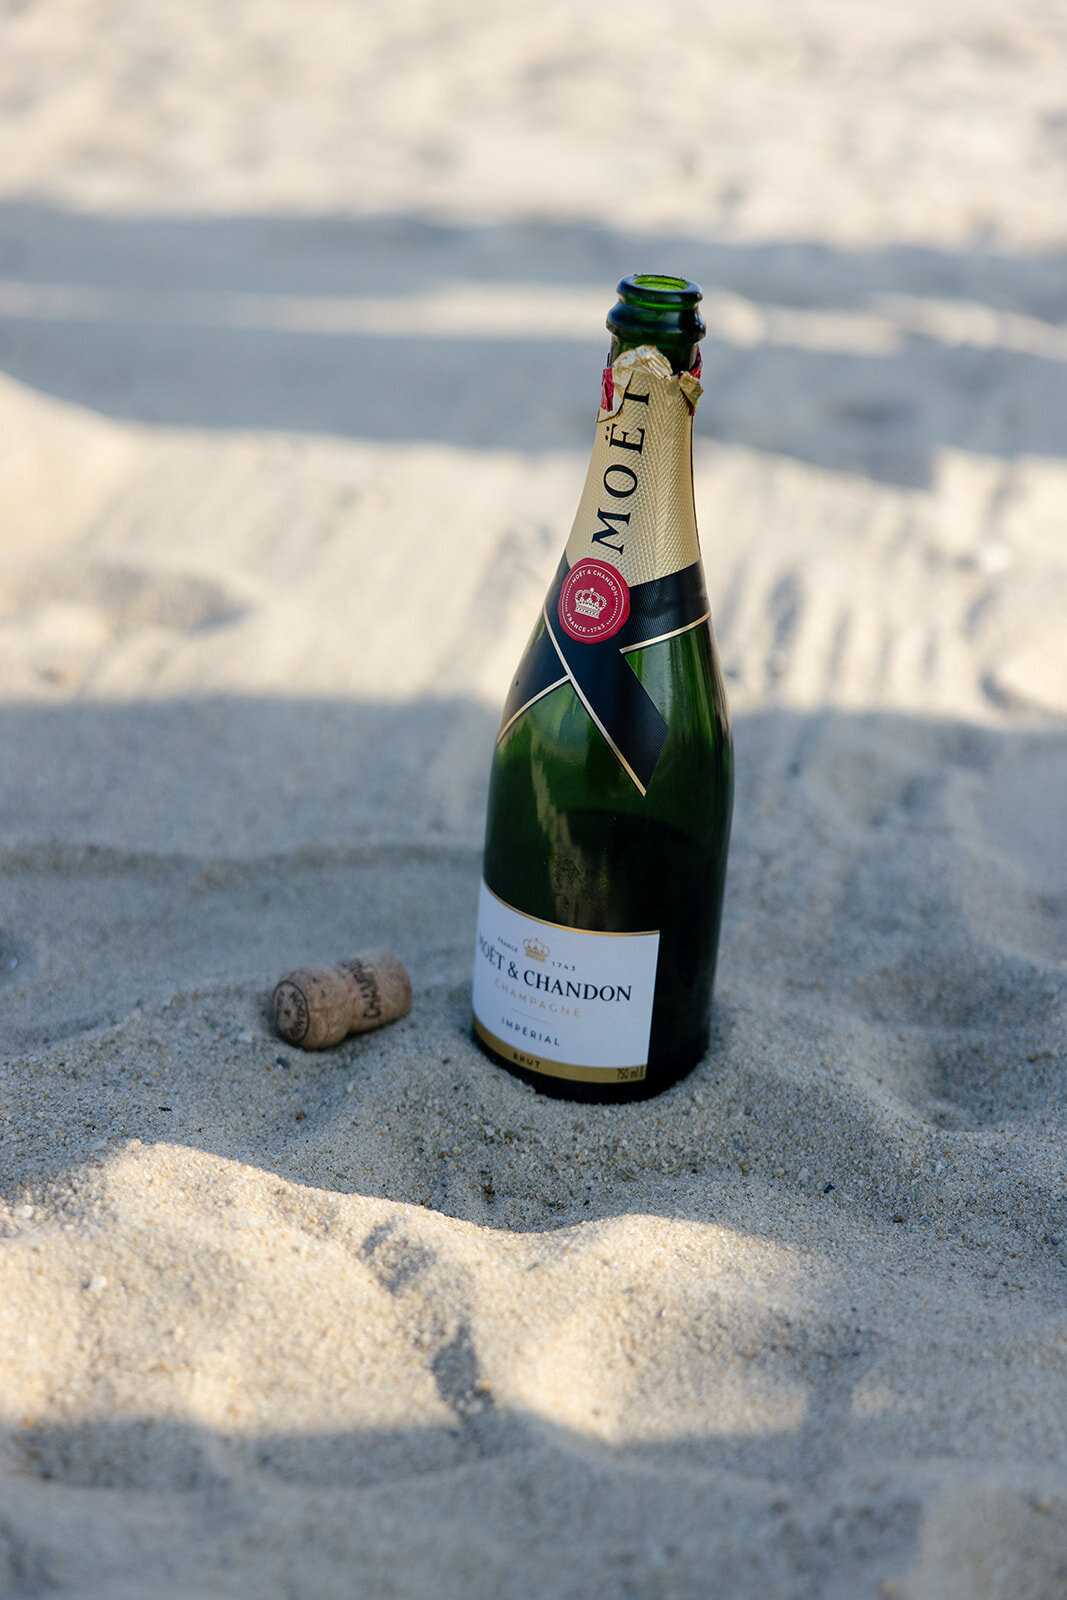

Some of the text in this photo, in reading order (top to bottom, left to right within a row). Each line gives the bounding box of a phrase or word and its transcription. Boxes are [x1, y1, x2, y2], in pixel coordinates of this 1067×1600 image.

[593, 570, 618, 596] CHANDON
[566, 613, 606, 633] FRANCE 1743
[497, 936, 518, 953] FRANCE
[551, 961, 576, 971] 1743
[507, 961, 519, 980] &
[523, 969, 633, 1002] CHANDON
[495, 978, 581, 1018] CHAMPAGNE
[501, 1016, 561, 1046] IMPÉRIAL
[513, 1052, 541, 1068] BRUT
[616, 1067, 630, 1081] 750
